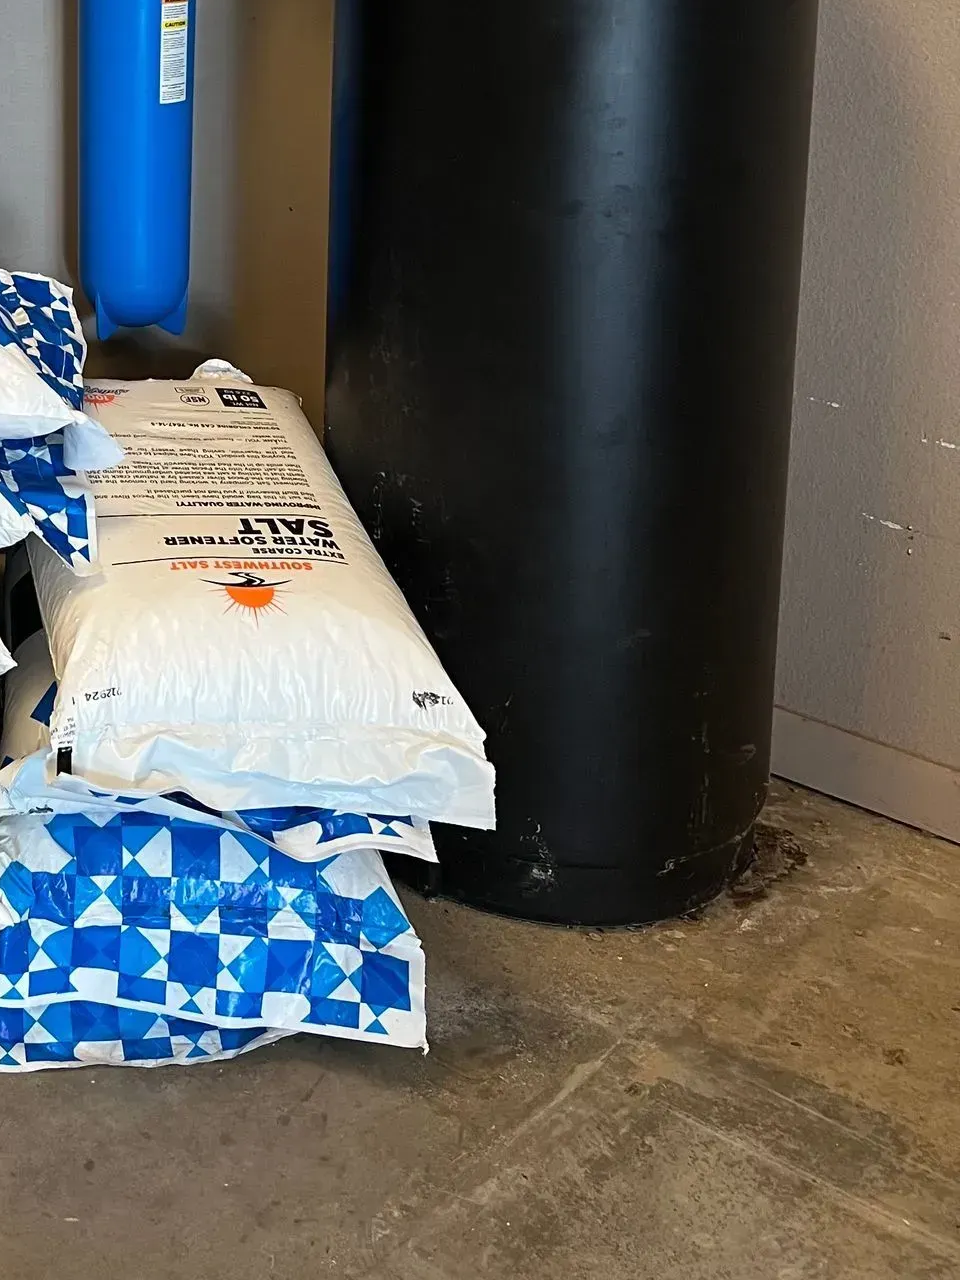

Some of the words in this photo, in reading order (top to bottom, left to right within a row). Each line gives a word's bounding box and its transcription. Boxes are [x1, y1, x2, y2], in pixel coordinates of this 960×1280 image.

[184, 396, 206, 404] NSF
[240, 395, 259, 403] 50
[263, 502, 322, 510] IMPROVING
[237, 517, 334, 538] SALT
[163, 536, 268, 546] SOFTENER
[272, 536, 341, 551] WATER
[252, 547, 302, 555] COARSE
[304, 548, 345, 560] EXTRA
[169, 560, 210, 571] SALT
[213, 560, 313, 571] SOUTHWEST
